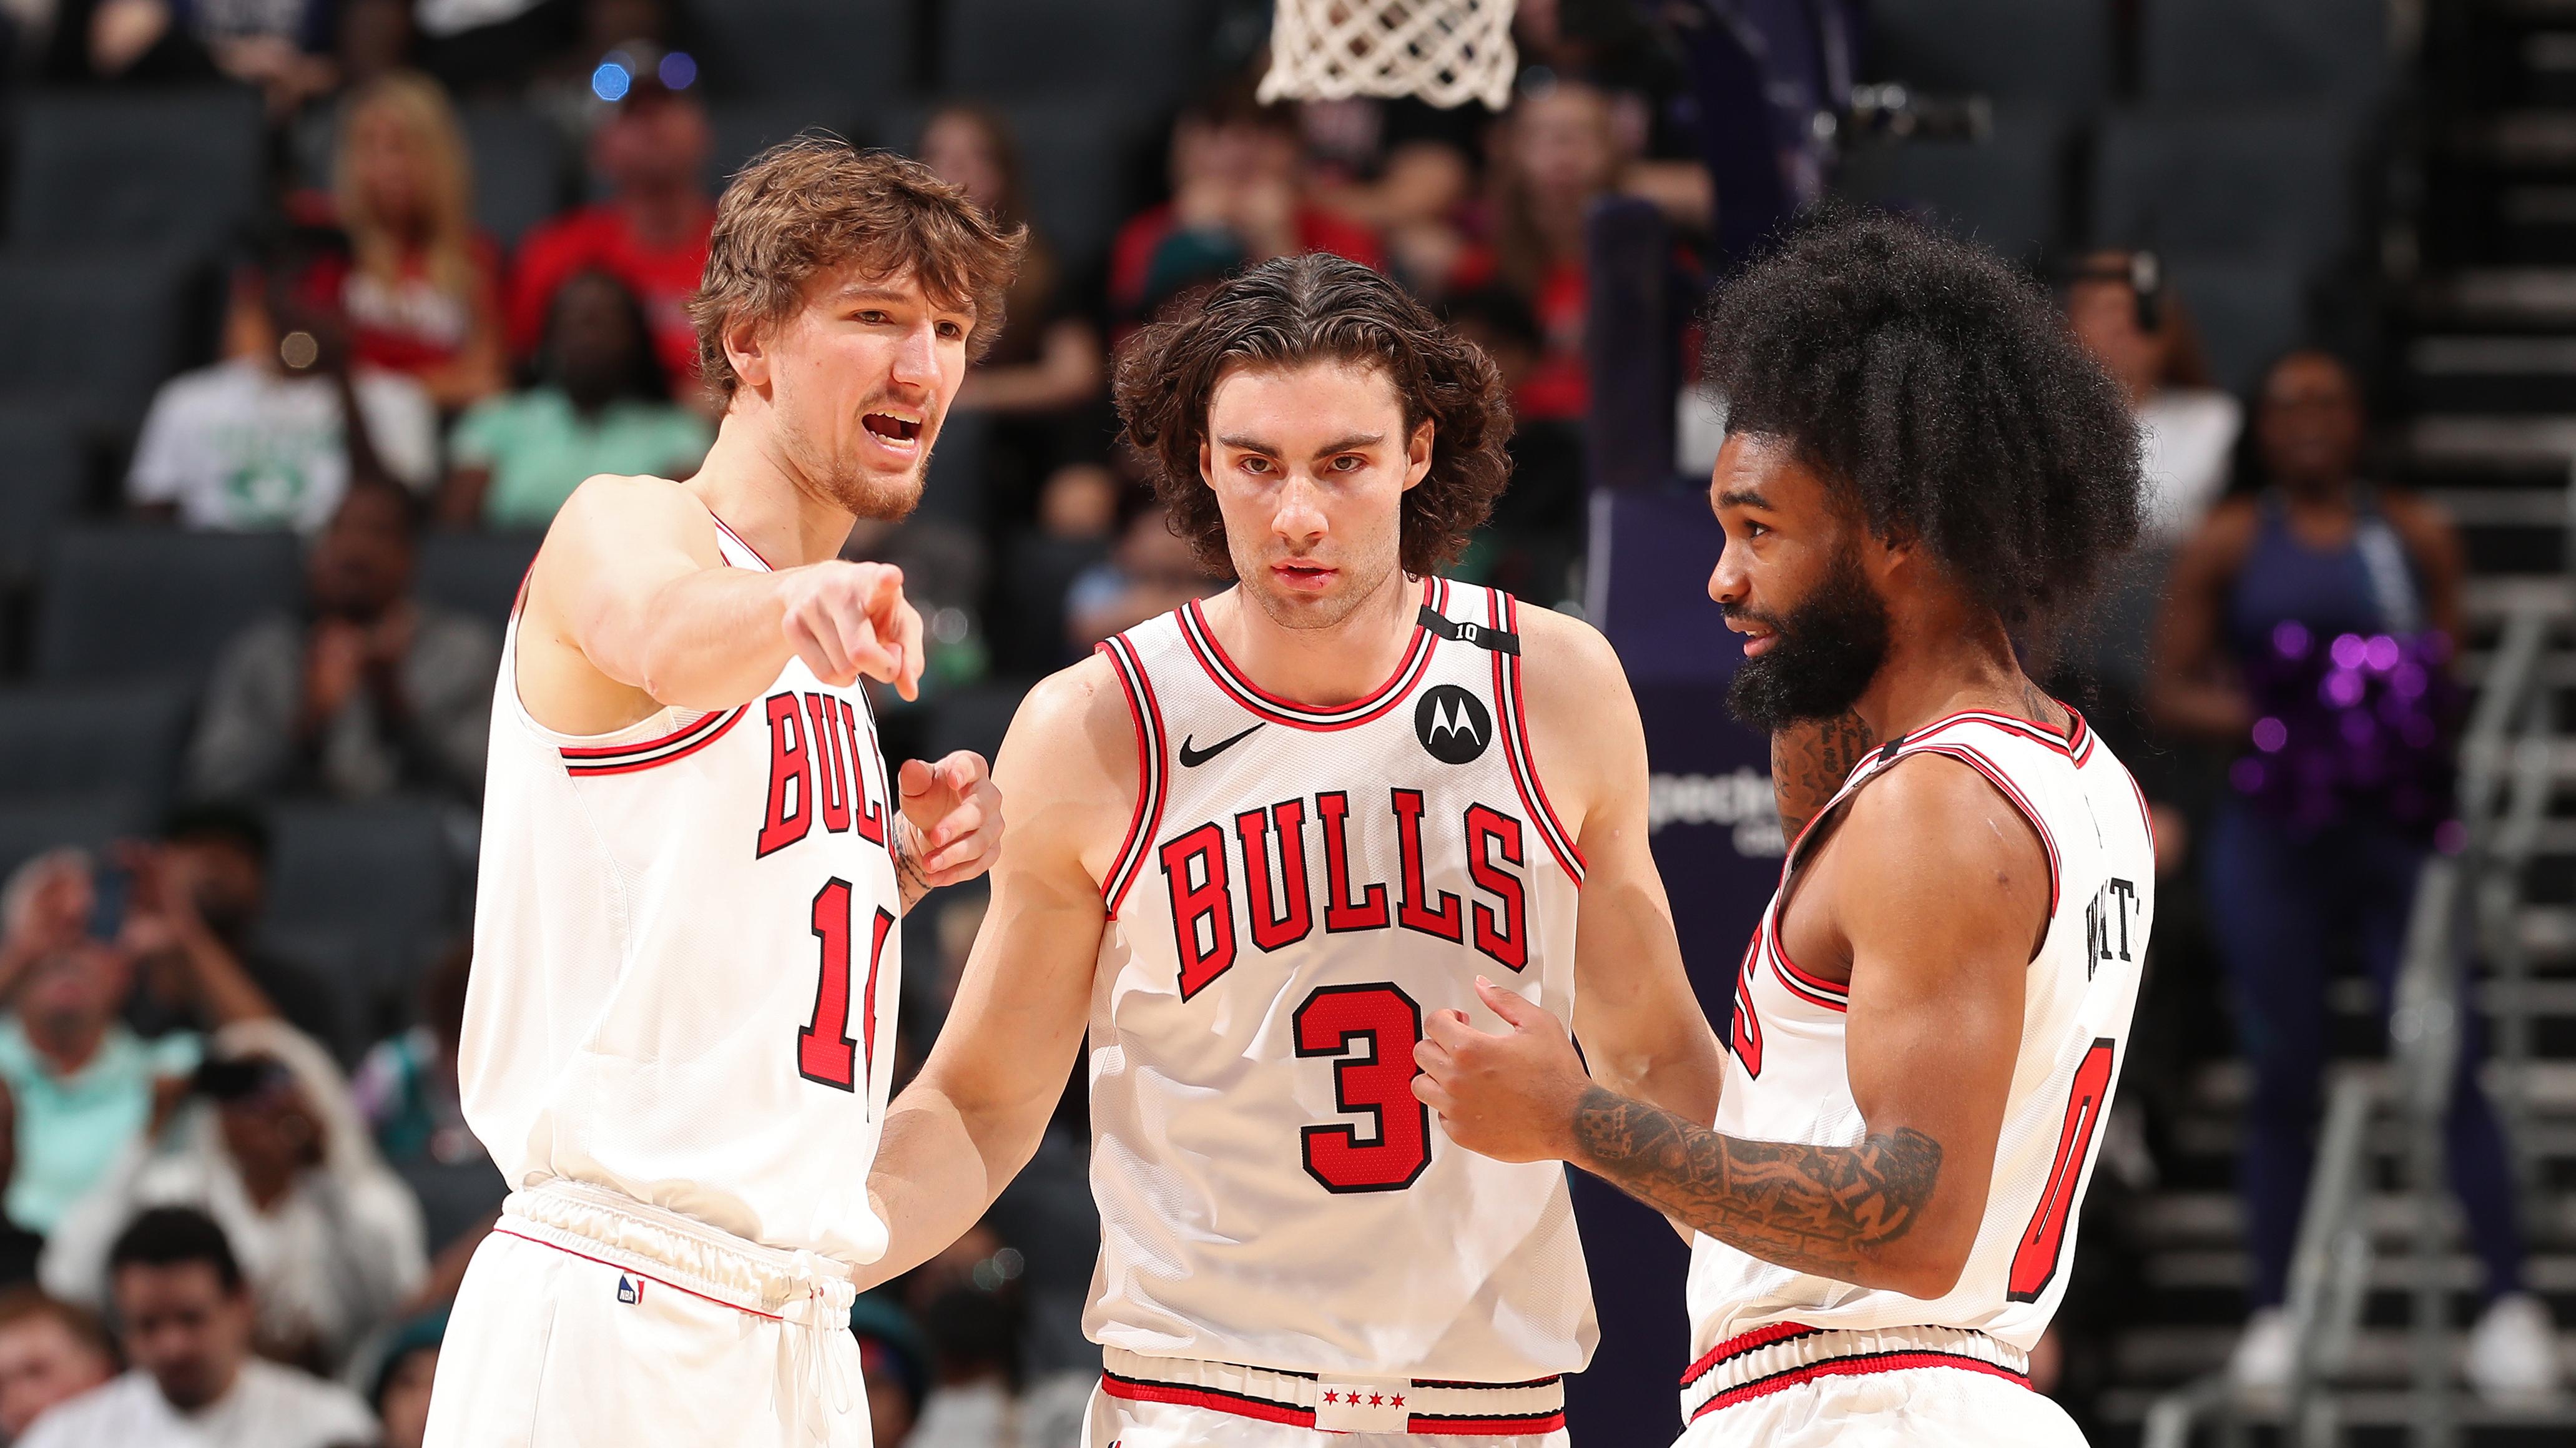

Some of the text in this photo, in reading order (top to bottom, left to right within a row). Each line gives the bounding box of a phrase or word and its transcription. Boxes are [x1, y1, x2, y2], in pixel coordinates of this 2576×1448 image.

[1455, 624, 1478, 642] 10
[1158, 787, 1529, 1004] BULLS
[1292, 981, 1432, 1194] 3
[2006, 1037, 2116, 1304] 0
[619, 1289, 634, 1302] NBA
